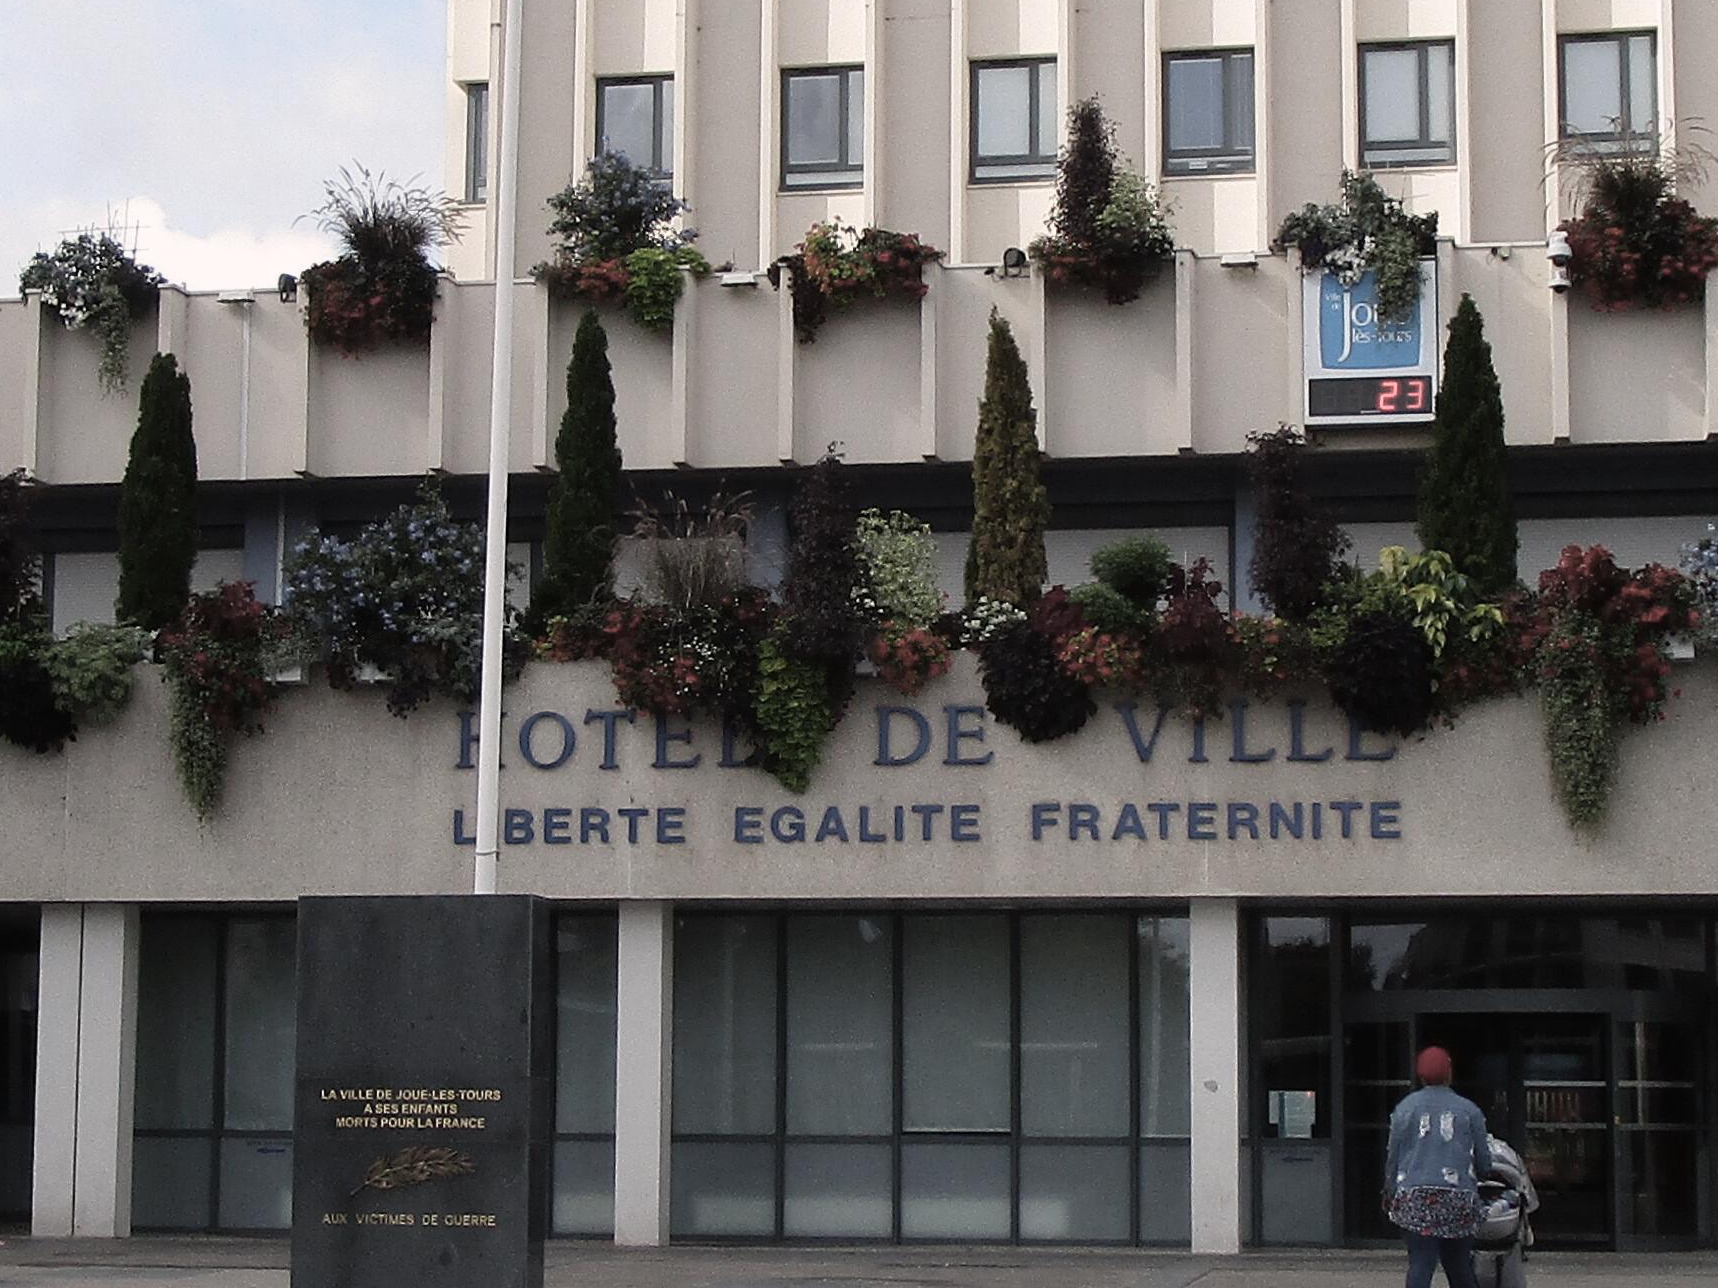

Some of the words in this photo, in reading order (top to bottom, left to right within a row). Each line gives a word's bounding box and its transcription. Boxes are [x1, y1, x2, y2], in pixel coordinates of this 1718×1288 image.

[1378, 379, 1425, 410] 23
[455, 708, 763, 770] HOTEL
[873, 704, 996, 767] DE
[452, 806, 687, 845] LBERTE
[733, 803, 982, 844] EGALITE
[1031, 800, 1403, 843] FRATERNITE
[321, 1089, 337, 1101] LA
[340, 1089, 373, 1101] VILLE
[376, 1089, 393, 1101] DE
[363, 1103, 373, 1115] A
[375, 1103, 399, 1115] SES
[401, 1103, 458, 1115] ENFANTS
[335, 1117, 378, 1129] MORTS
[380, 1117, 415, 1129] POUR
[417, 1117, 433, 1129] LA
[435, 1117, 486, 1129] FRANCE
[322, 1213, 348, 1225] AUX
[355, 1213, 415, 1226] VICTIMES
[421, 1214, 439, 1226] DE
[444, 1214, 496, 1227] GUERRE
